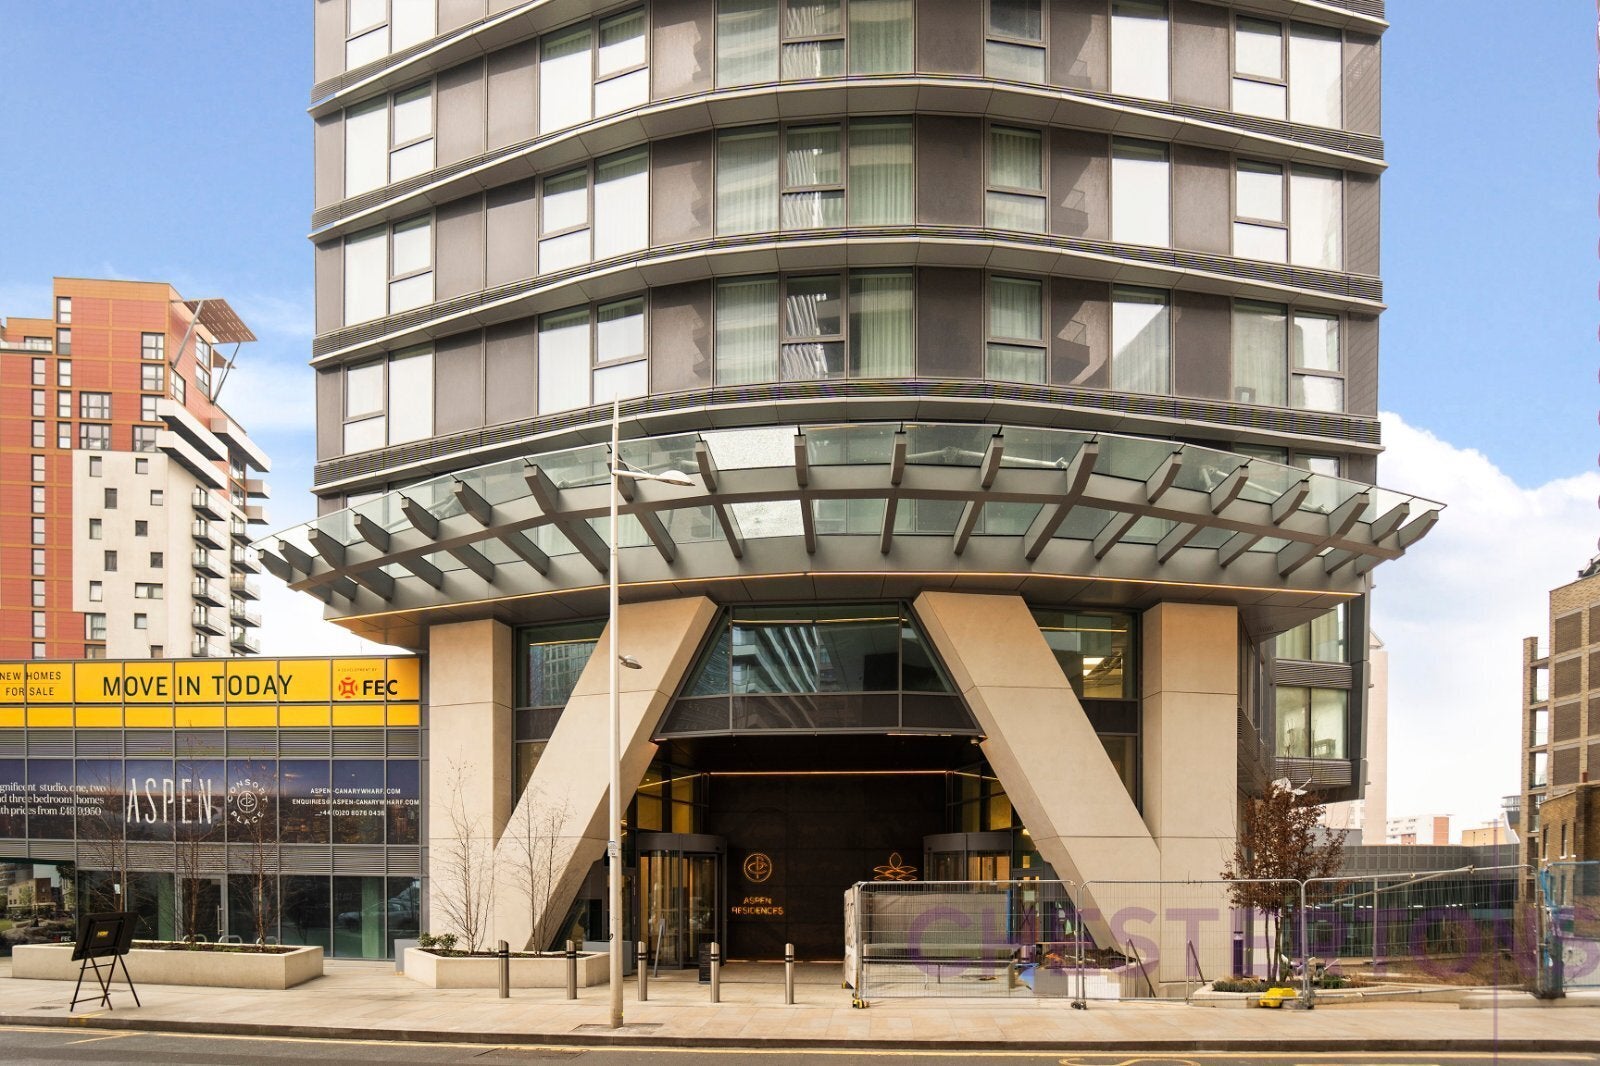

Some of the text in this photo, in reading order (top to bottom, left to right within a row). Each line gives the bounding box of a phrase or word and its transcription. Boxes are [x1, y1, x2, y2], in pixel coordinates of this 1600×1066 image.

[0, 671, 62, 681] NEW HOMES
[103, 675, 293, 696] MOVE IN TODAY
[363, 679, 398, 696] FEC
[5, 687, 55, 696] FOR SALE
[39, 782, 68, 793] studio,
[89, 784, 107, 792] two
[8, 793, 33, 803] three
[33, 793, 72, 804] bedroom
[76, 794, 105, 804] homes
[126, 777, 212, 825] ASPEN
[37, 805, 58, 815] from
[230, 810, 264, 825] PLACE
[743, 896, 773, 905] ASPEN
[731, 906, 785, 916] RESIDENCES
